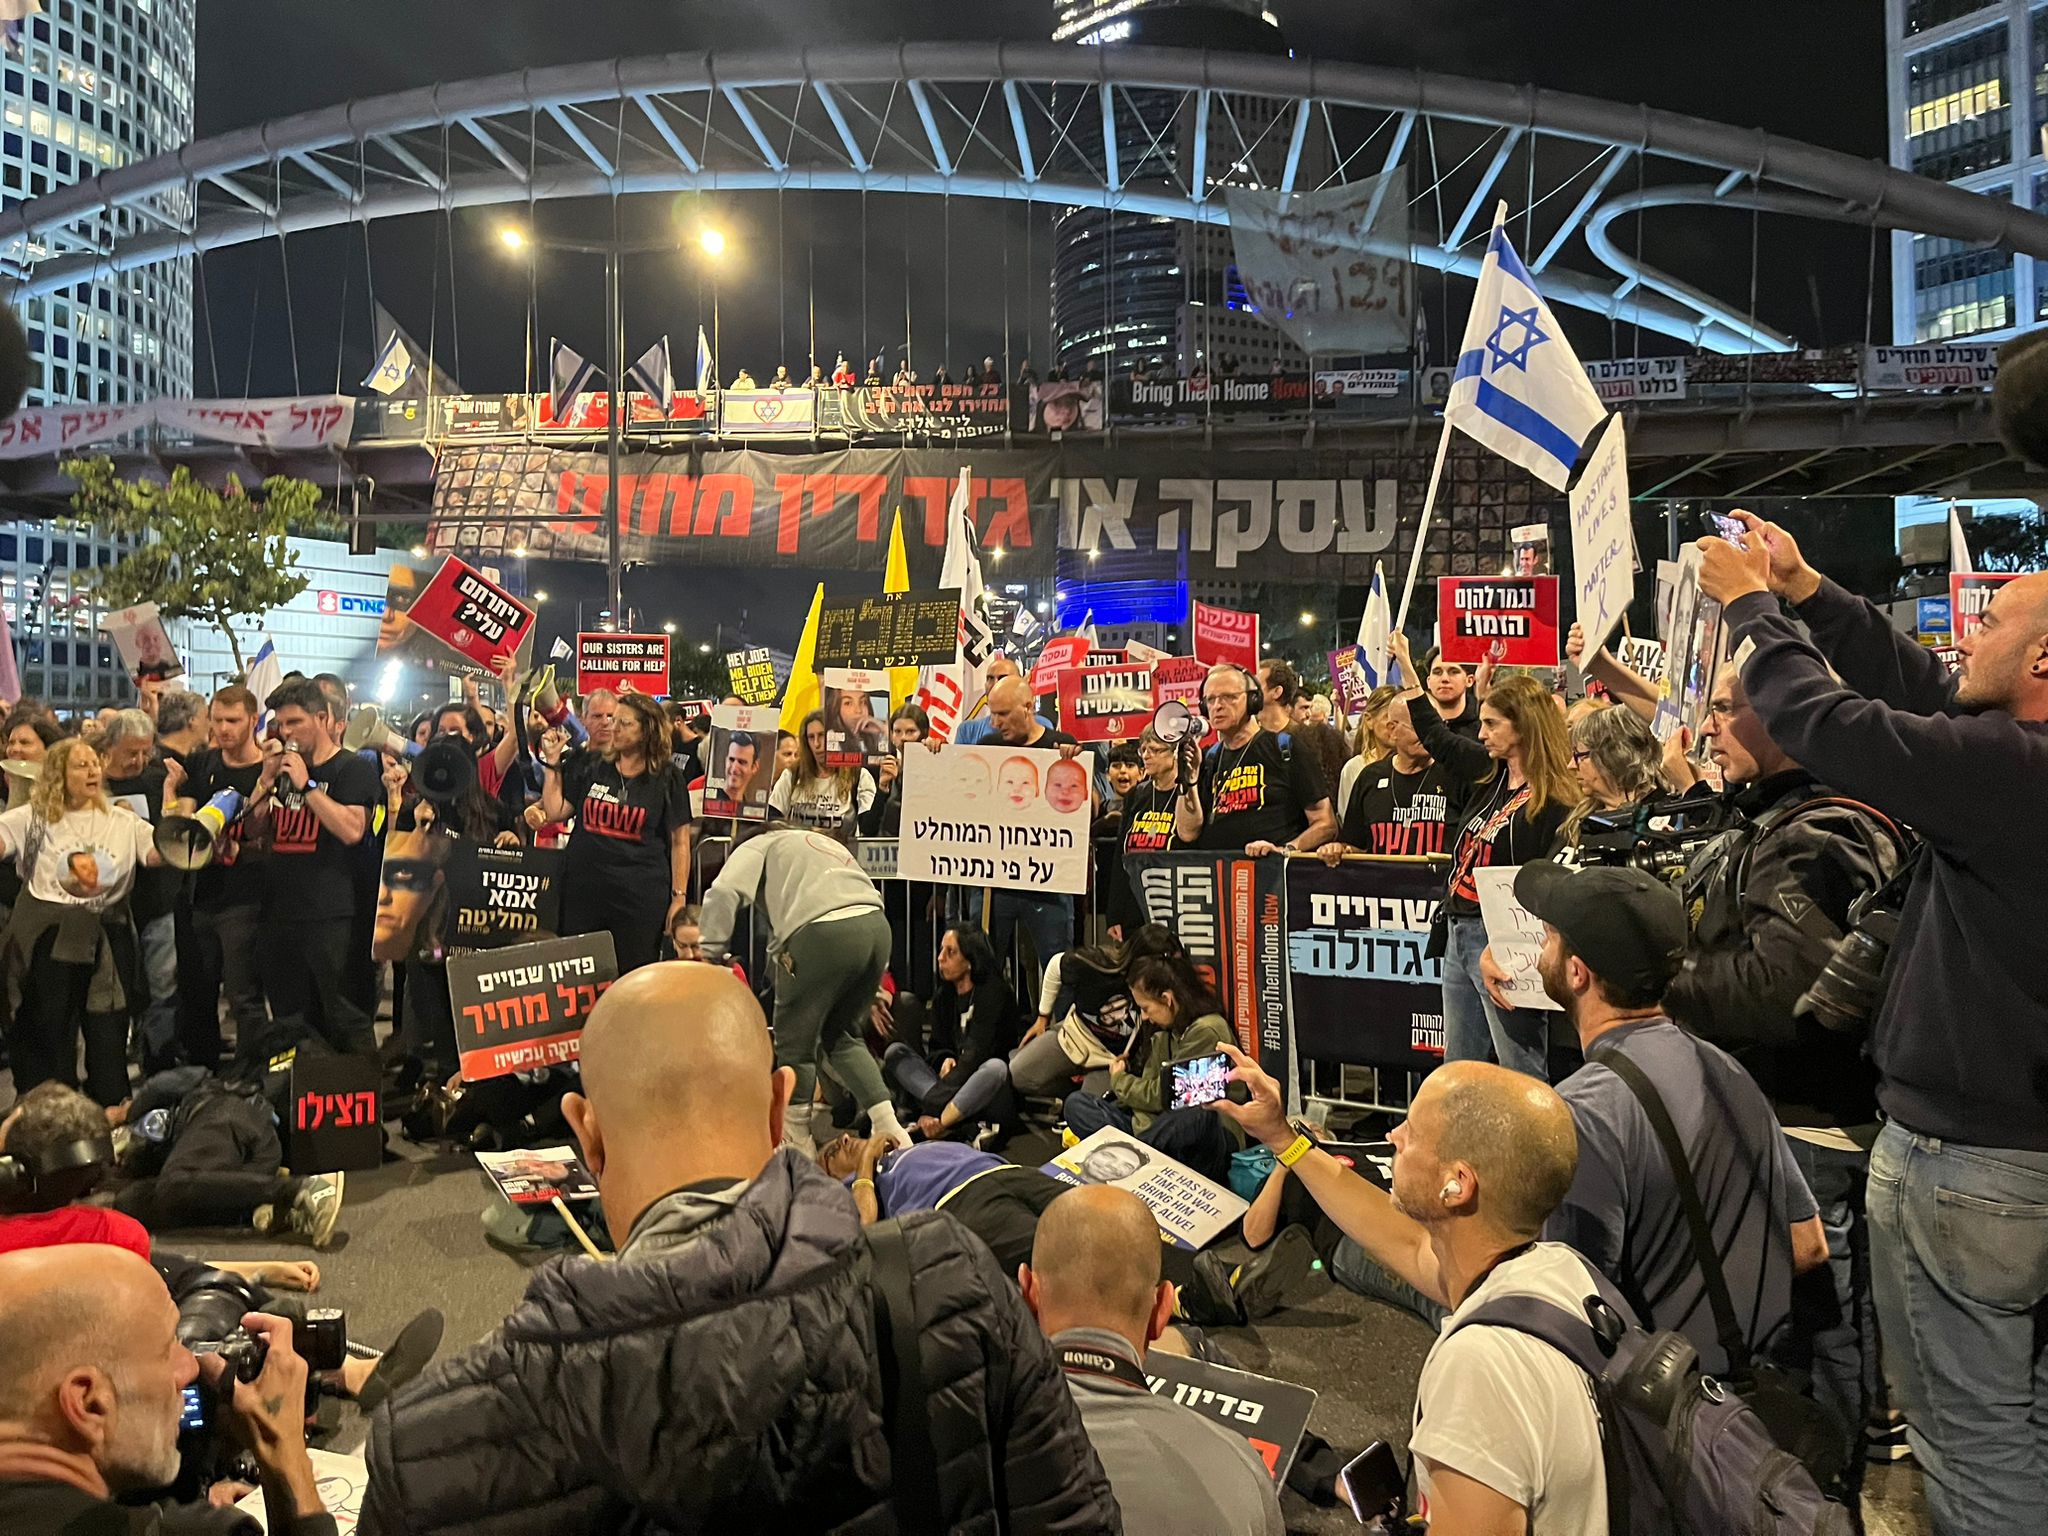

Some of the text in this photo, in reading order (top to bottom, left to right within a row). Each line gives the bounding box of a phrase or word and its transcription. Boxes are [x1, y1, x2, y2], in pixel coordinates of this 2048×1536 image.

[1132, 380, 1173, 407] Bring
[1224, 379, 1268, 401] Home
[1577, 446, 1617, 527] HOSTAGE
[774, 473, 888, 553] דין
[904, 477, 1032, 547] גזר
[1050, 478, 1138, 550] או
[1157, 478, 1398, 568] עסקה
[1588, 486, 1617, 545] LIVES
[1584, 538, 1625, 603] MATTER
[459, 575, 521, 627] ויתרתם
[886, 592, 903, 602] את
[1496, 587, 1536, 609] נגמר
[460, 602, 504, 640] עלי?
[817, 597, 959, 660] כולם
[1198, 604, 1250, 630] עסקה
[1464, 613, 1525, 637] הזמן!
[582, 642, 664, 655] OUR SISTERS ARE
[726, 647, 770, 668] HEY JOE!
[1040, 647, 1068, 663] עסקה
[580, 659, 666, 673] CALLING FOR HELP
[729, 661, 773, 680] MR. BIDEN
[731, 674, 776, 696] HELP US
[1164, 686, 1200, 701] סקה
[583, 796, 646, 835] NOW!
[1412, 793, 1447, 808] מחזירים
[1421, 806, 1446, 822] אותם
[913, 816, 1074, 851] הניצחון המוחלט
[929, 854, 1055, 884] על פי נתניהו
[488, 888, 537, 910] אמא
[1175, 866, 1216, 956] הביתה
[1311, 893, 1440, 932] שבויים
[458, 907, 538, 931] מחליטה
[477, 955, 595, 994] פדיון שבויים
[1260, 893, 1283, 1051] #BringThemHomeNow
[462, 992, 550, 1035] מחיר
[493, 1047, 546, 1070] עכשיו!
[297, 1090, 376, 1132] הצילו
[1138, 1181, 1196, 1217] BRING HIM
[1150, 1174, 1179, 1194] TIME
[1179, 1189, 1193, 1202] TO
[1160, 1166, 1217, 1201] HE HAS NO
[1158, 1207, 1196, 1232] ALIVE!
[1063, 1351, 1116, 1373] Canon
[1172, 1382, 1265, 1425] פדיון
